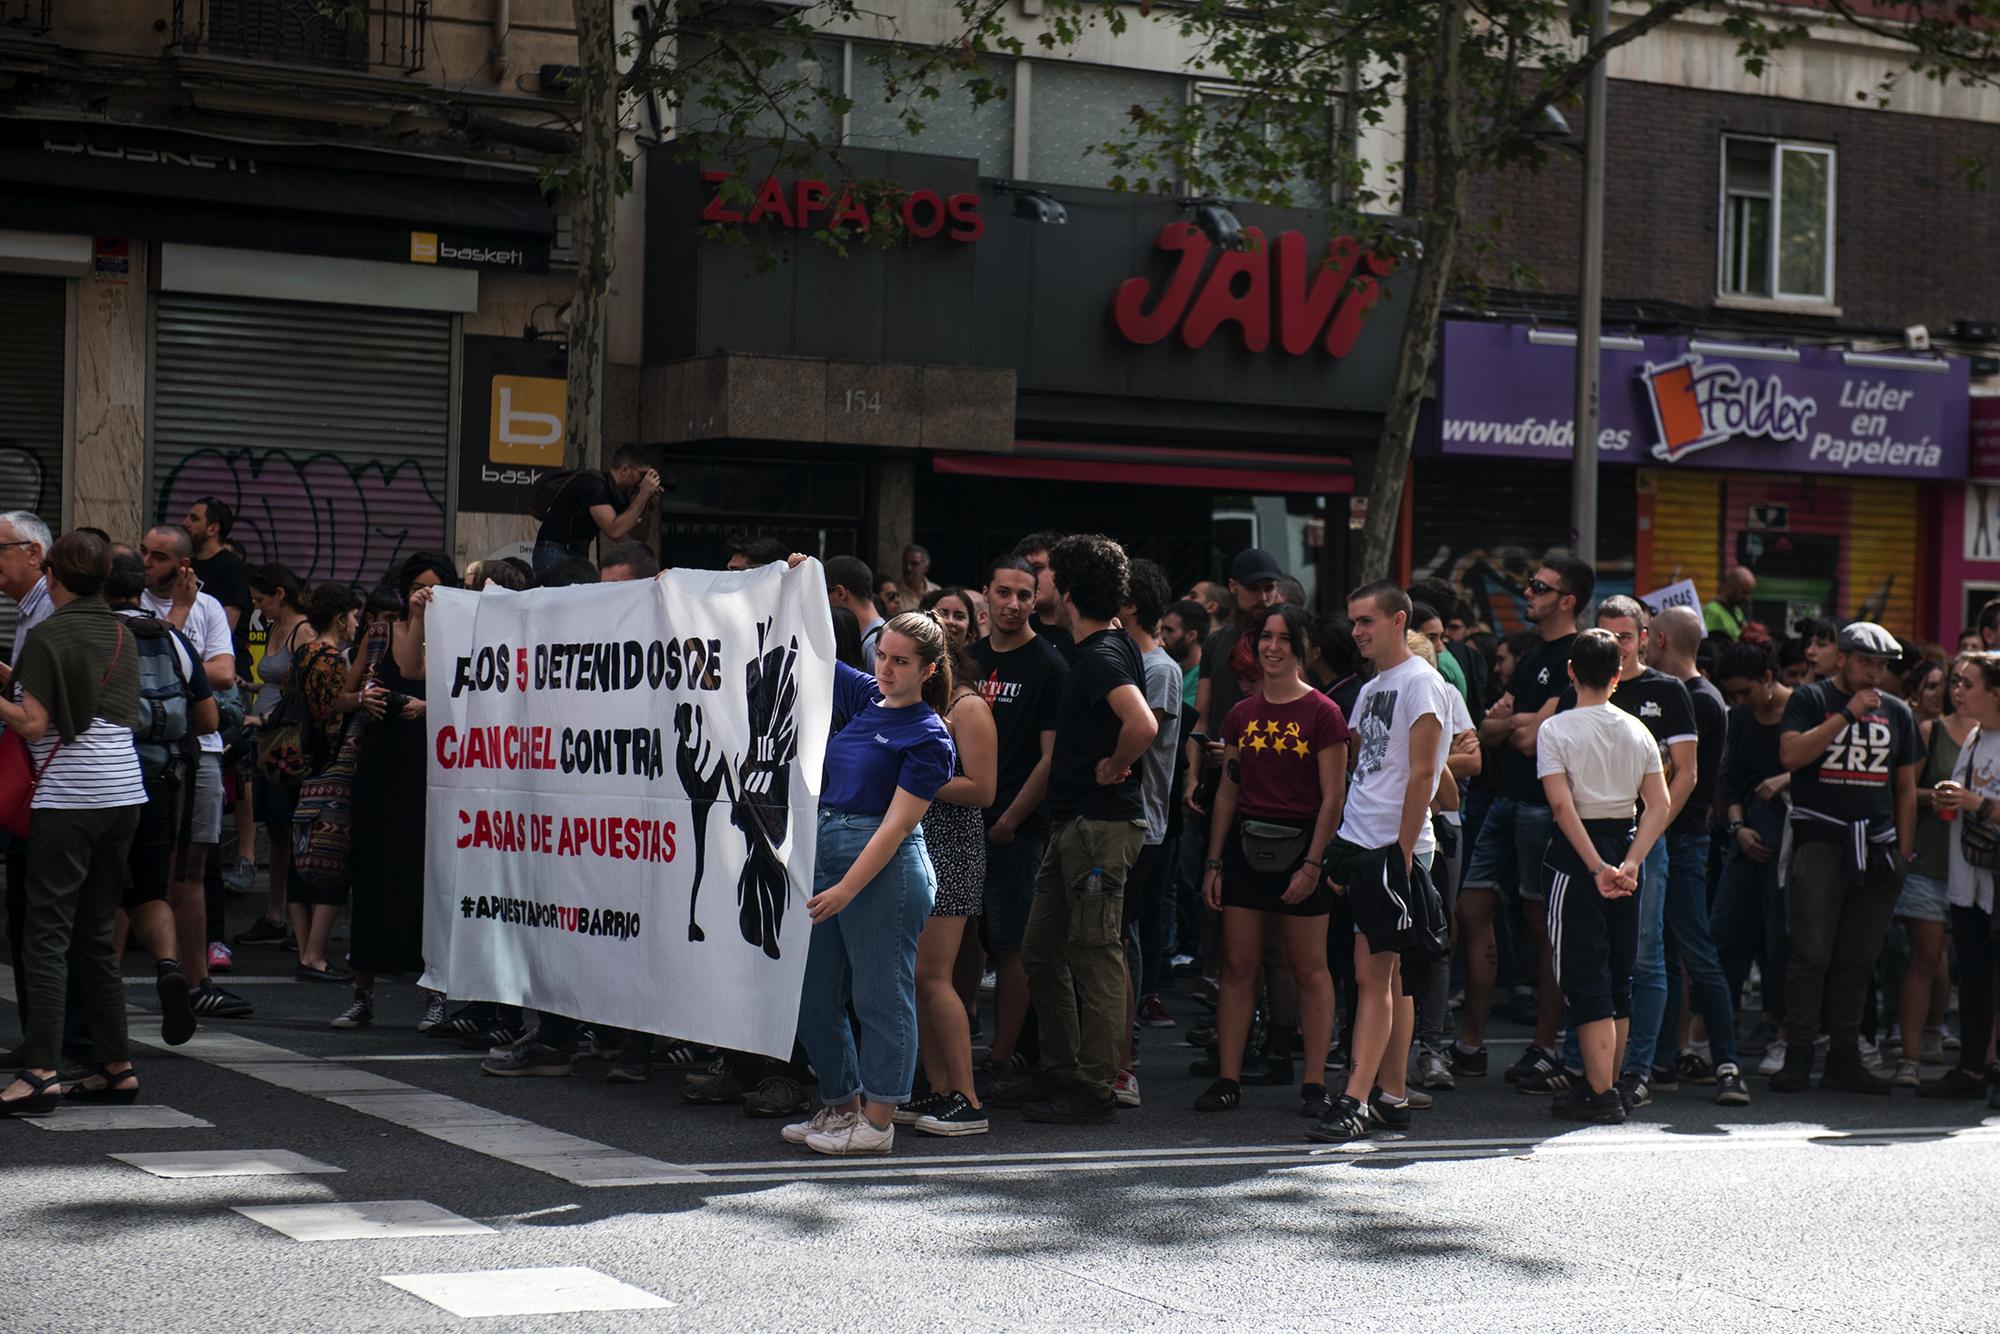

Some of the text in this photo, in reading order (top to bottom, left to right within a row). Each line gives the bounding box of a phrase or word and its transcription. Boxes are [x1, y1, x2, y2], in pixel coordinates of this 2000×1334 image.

[700, 171, 985, 242] ZAPAOS
[843, 389, 882, 415] 154
[1850, 413, 1887, 437] en
[1809, 432, 1942, 469] Papelería
[516, 647, 529, 693] 5
[560, 727, 664, 780] CONTRA
[1820, 743, 1891, 773] ZRZ
[531, 814, 553, 853] DE
[556, 817, 677, 864] APUESTAS
